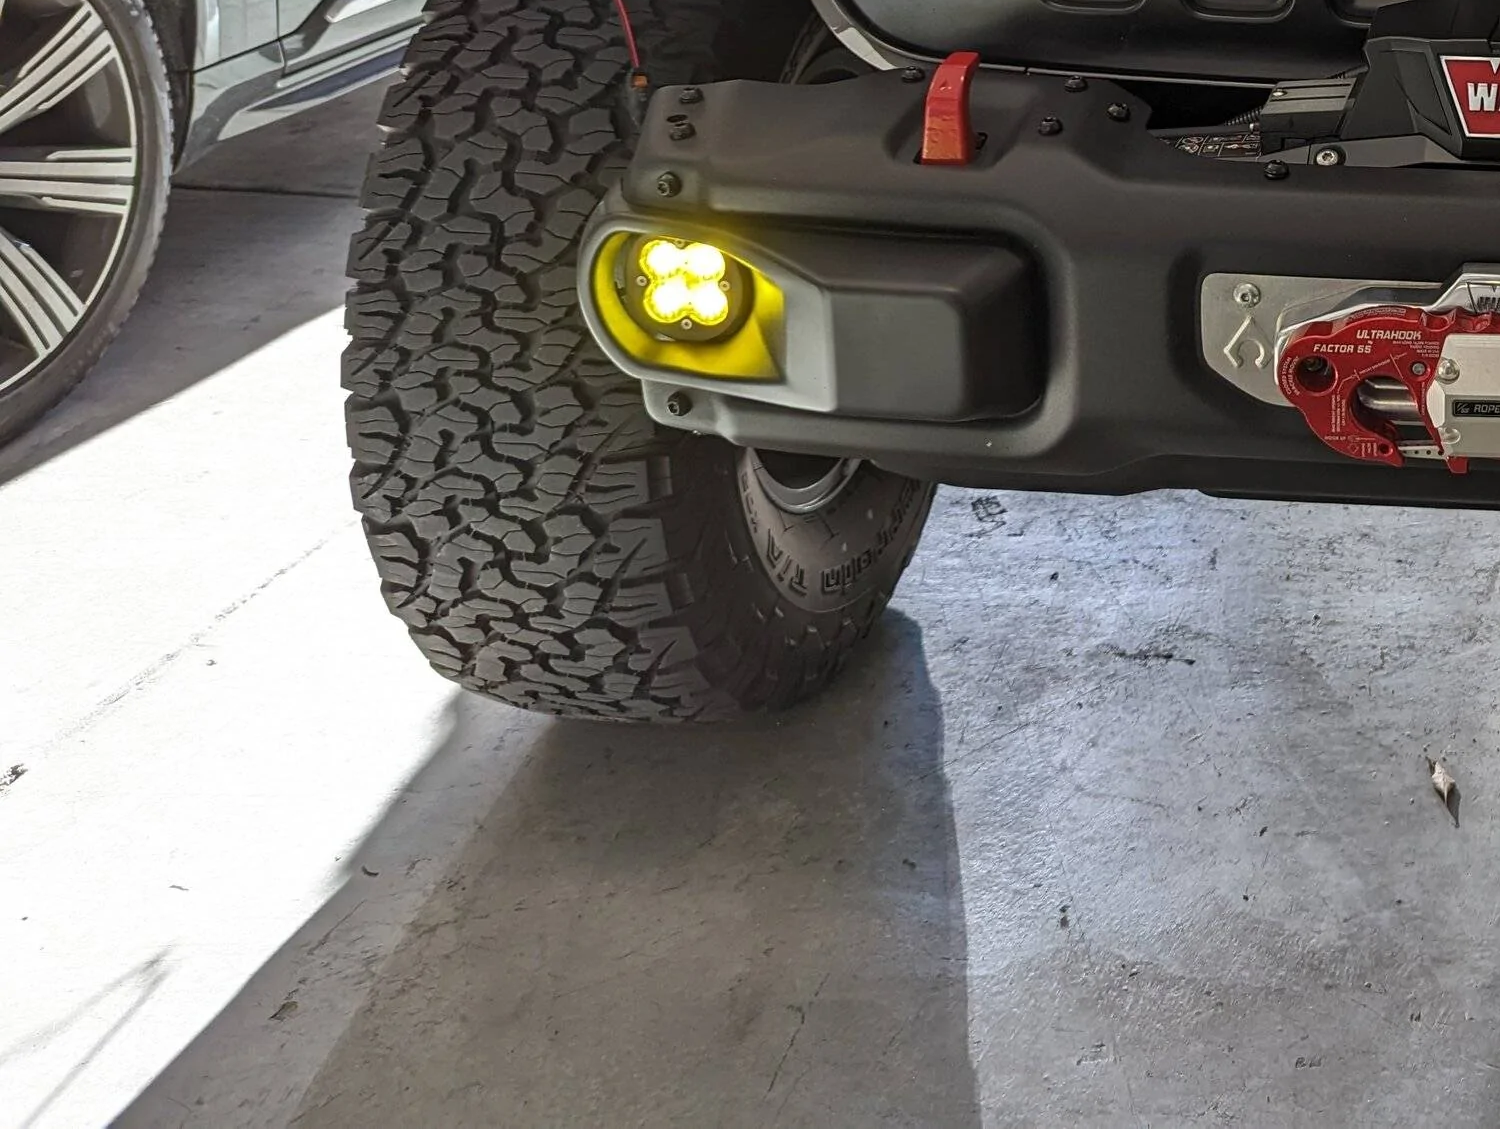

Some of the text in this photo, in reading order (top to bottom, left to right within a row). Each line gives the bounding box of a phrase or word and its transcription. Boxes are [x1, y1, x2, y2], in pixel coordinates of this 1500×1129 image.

[1356, 330, 1421, 340] ULTRAHOOK
[1313, 344, 1372, 354] FACTOR 55
